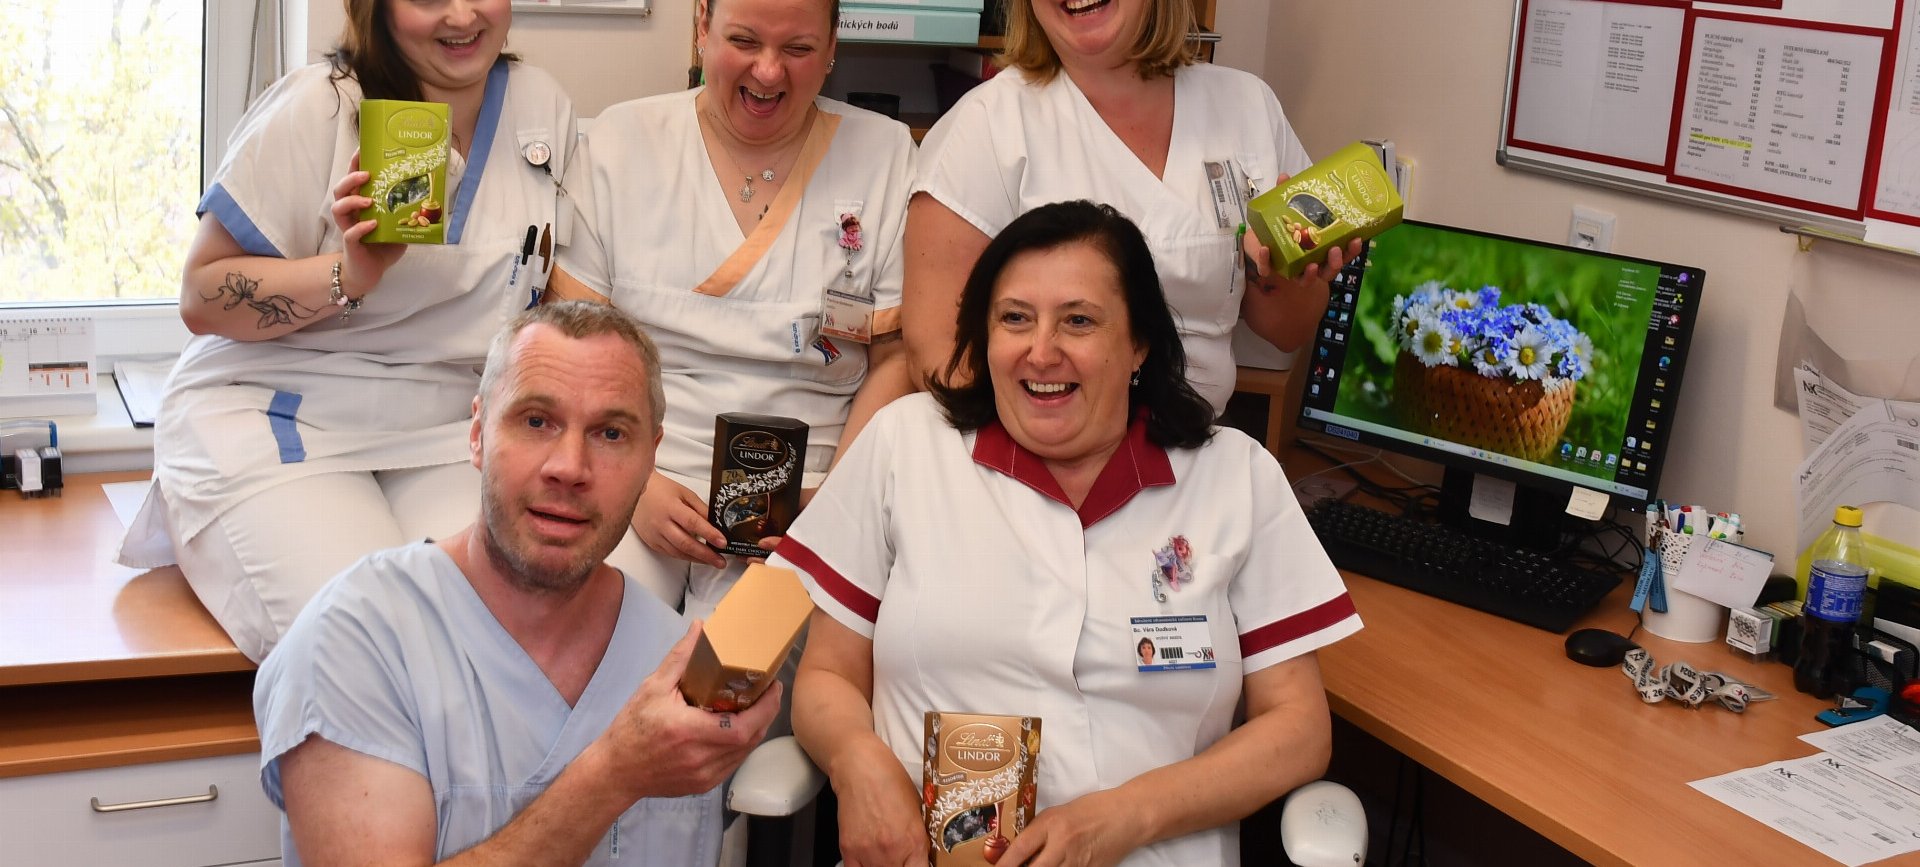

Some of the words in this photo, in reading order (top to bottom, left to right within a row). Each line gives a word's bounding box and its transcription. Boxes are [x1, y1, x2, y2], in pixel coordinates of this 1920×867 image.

[838, 19, 873, 30] itických
[876, 20, 899, 30] bodů
[398, 131, 433, 140] LINDOR
[1351, 174, 1373, 206] LINDOR
[739, 451, 774, 462] LINDOR
[958, 750, 1000, 762] LINDOR
